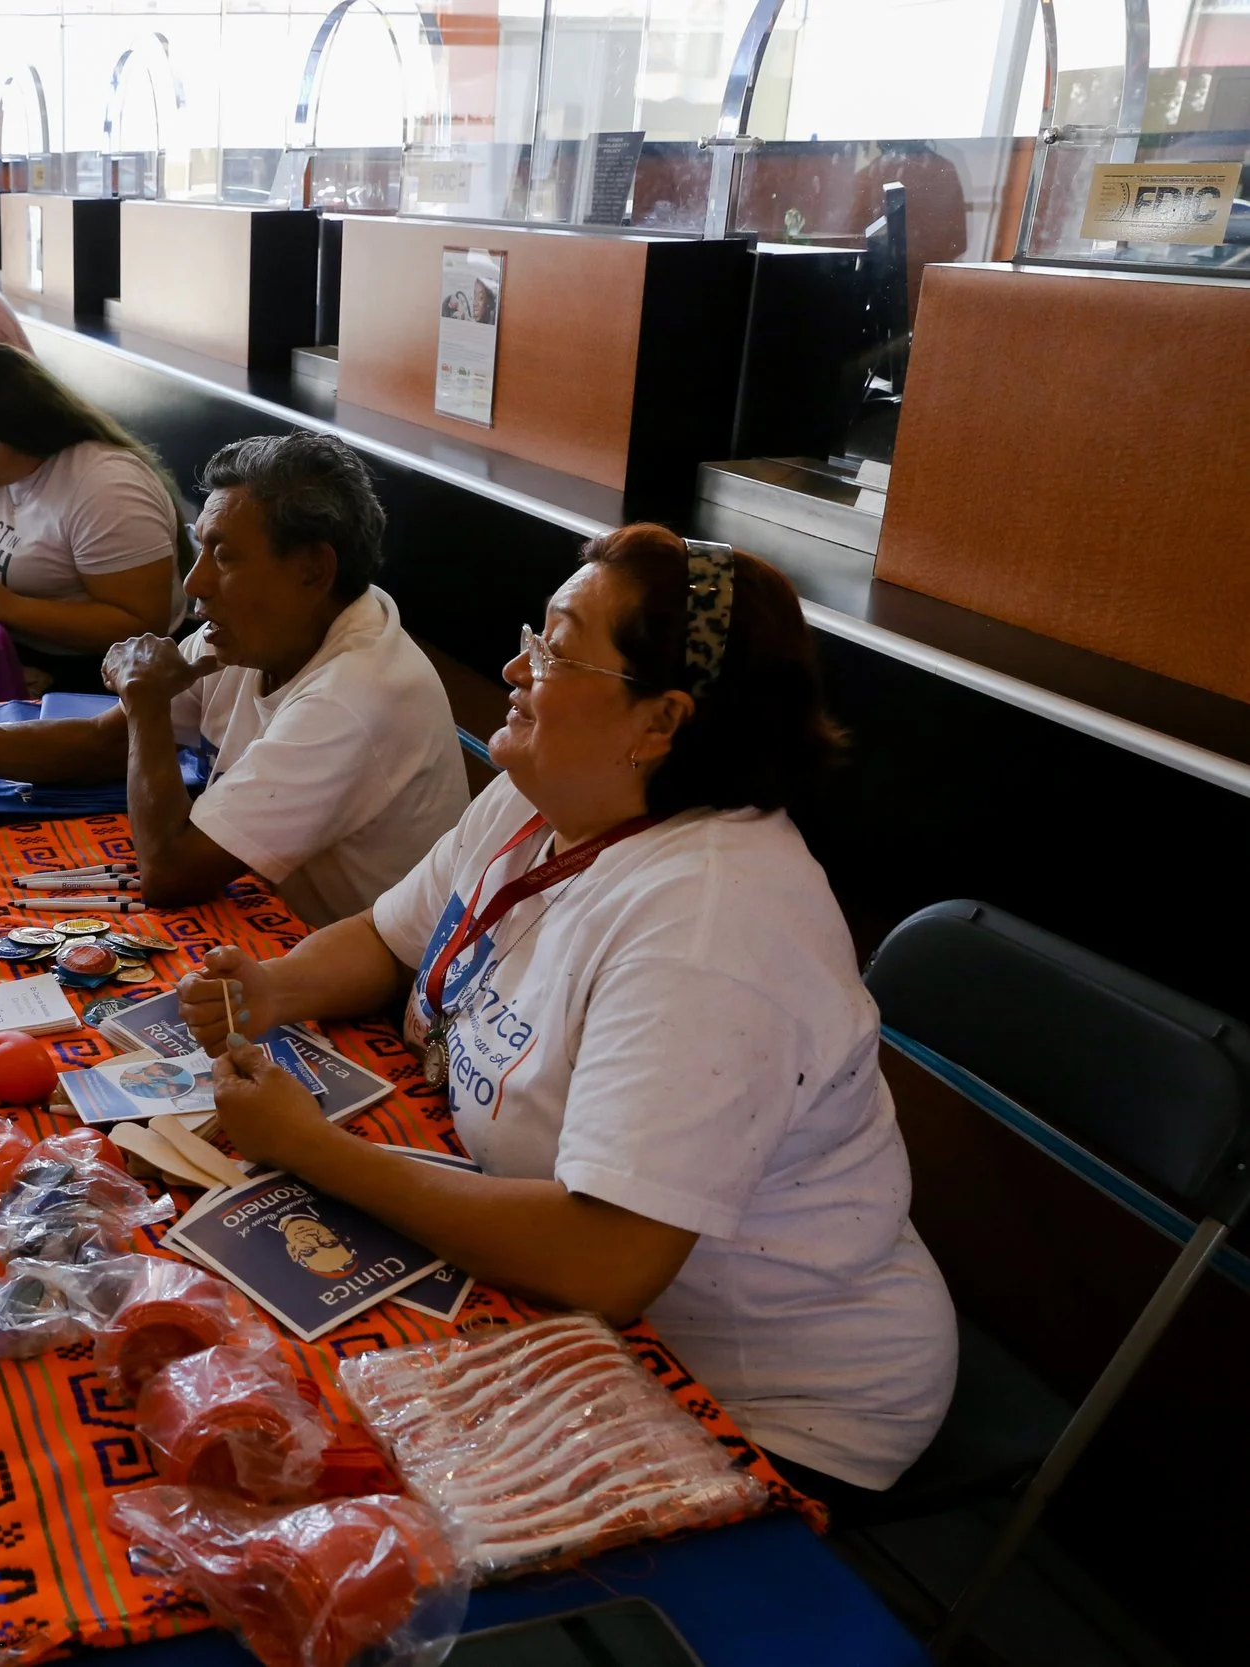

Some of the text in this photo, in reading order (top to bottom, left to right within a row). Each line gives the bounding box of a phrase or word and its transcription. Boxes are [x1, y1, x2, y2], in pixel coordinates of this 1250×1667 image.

[1131, 186, 1221, 222] FDIC
[144, 1023, 191, 1057] Rome
[294, 1061, 313, 1084] Welcome
[222, 1183, 309, 1229] Romero
